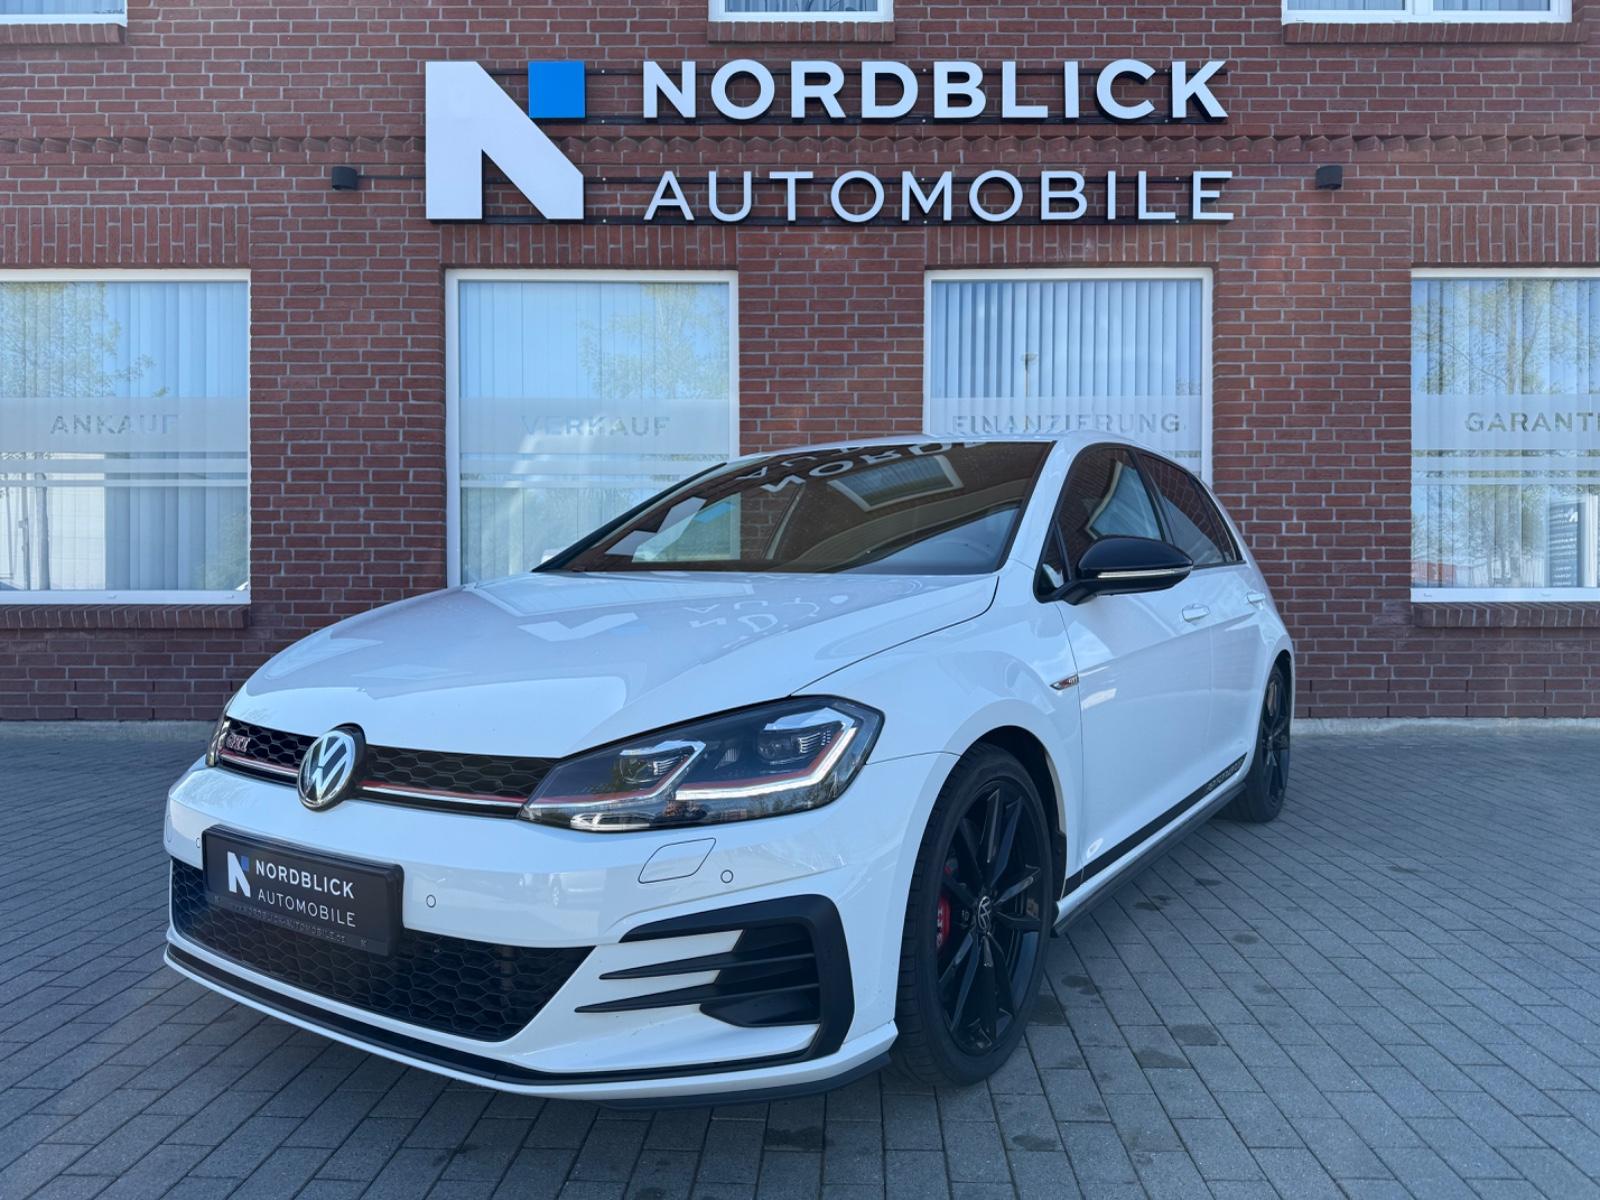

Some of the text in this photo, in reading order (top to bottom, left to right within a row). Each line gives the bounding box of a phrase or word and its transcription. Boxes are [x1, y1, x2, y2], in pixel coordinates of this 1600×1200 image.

[643, 59, 1229, 120] NORDBLICK
[643, 170, 1234, 222] AUTOMOBILE
[50, 414, 179, 434] ANKAUF
[520, 415, 671, 436] VERKAUF
[952, 413, 1181, 433] FINANZIERUNG
[256, 859, 355, 899] NORDBLICK
[258, 888, 356, 928] AUTOMOBILE
